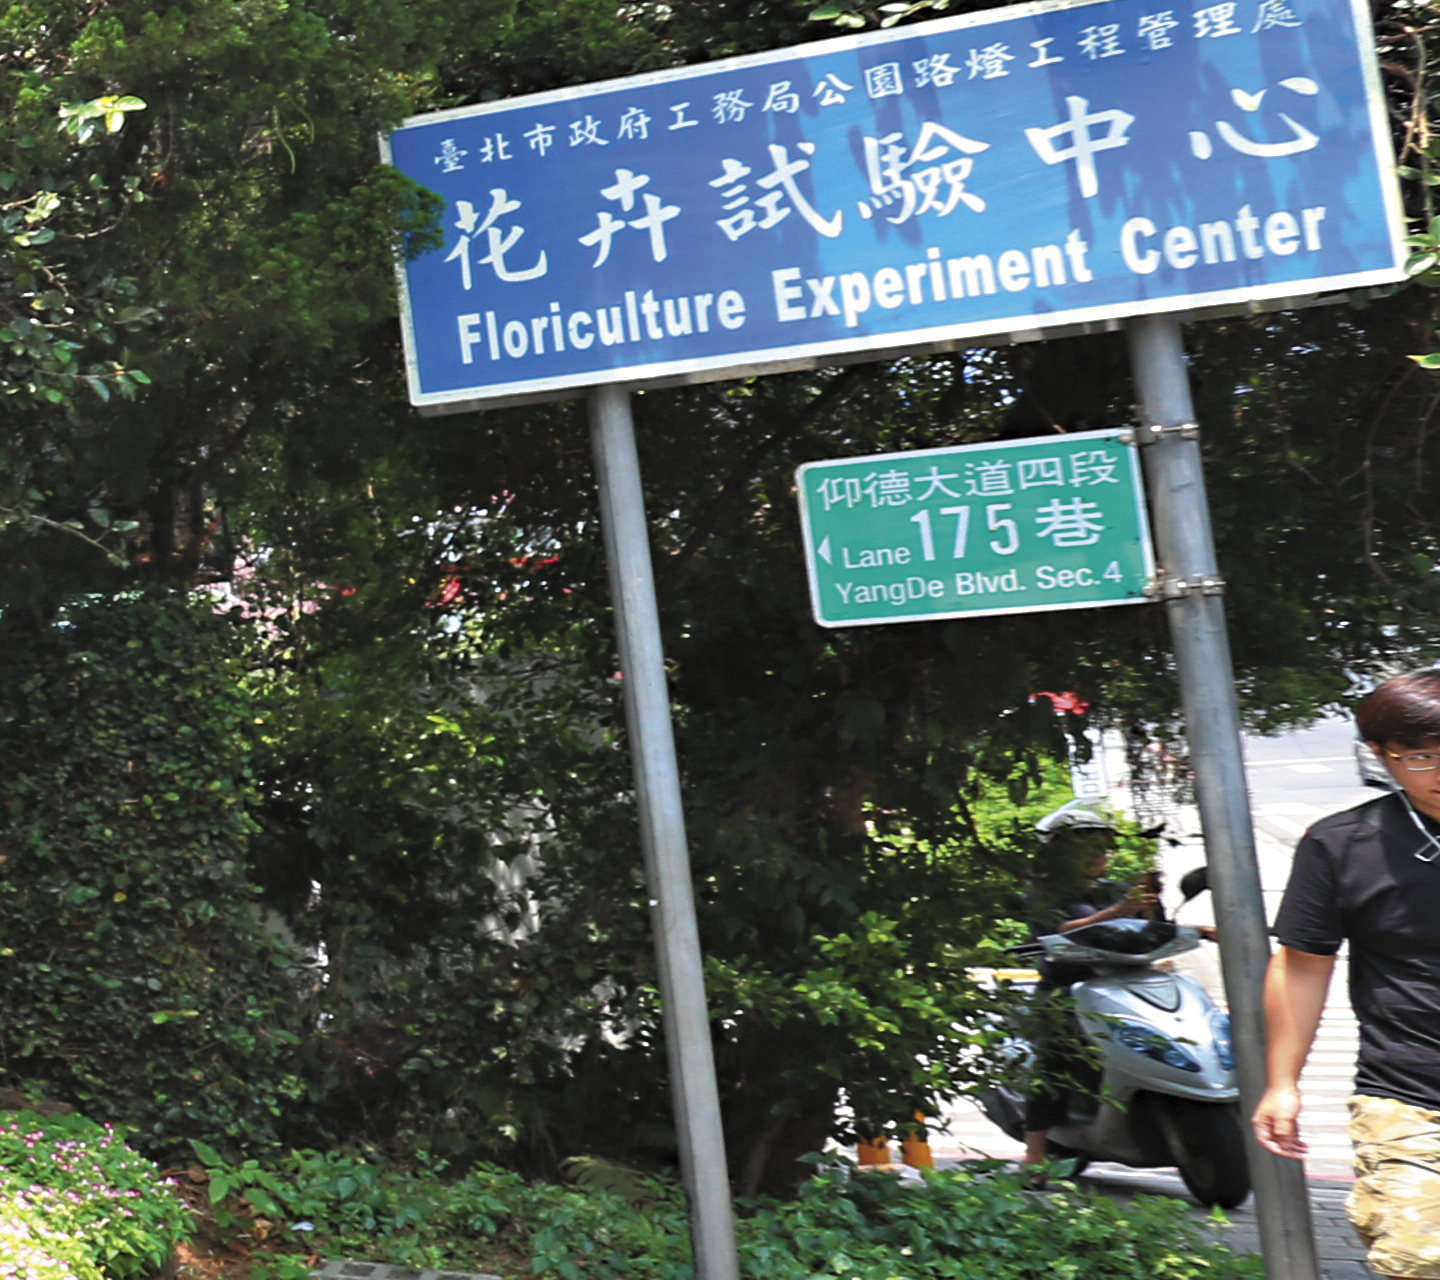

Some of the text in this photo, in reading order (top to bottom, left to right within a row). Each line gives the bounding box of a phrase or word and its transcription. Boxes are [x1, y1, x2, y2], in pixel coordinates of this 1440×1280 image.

[444, 76, 1320, 290] 花卉試驗中心
[457, 204, 1326, 364] Floriculture Experiment Center
[816, 449, 1121, 511] 仰德大道四段
[835, 576, 946, 606] YangDe
[956, 569, 1027, 596] Blvd.
[841, 546, 911, 569] Lane
